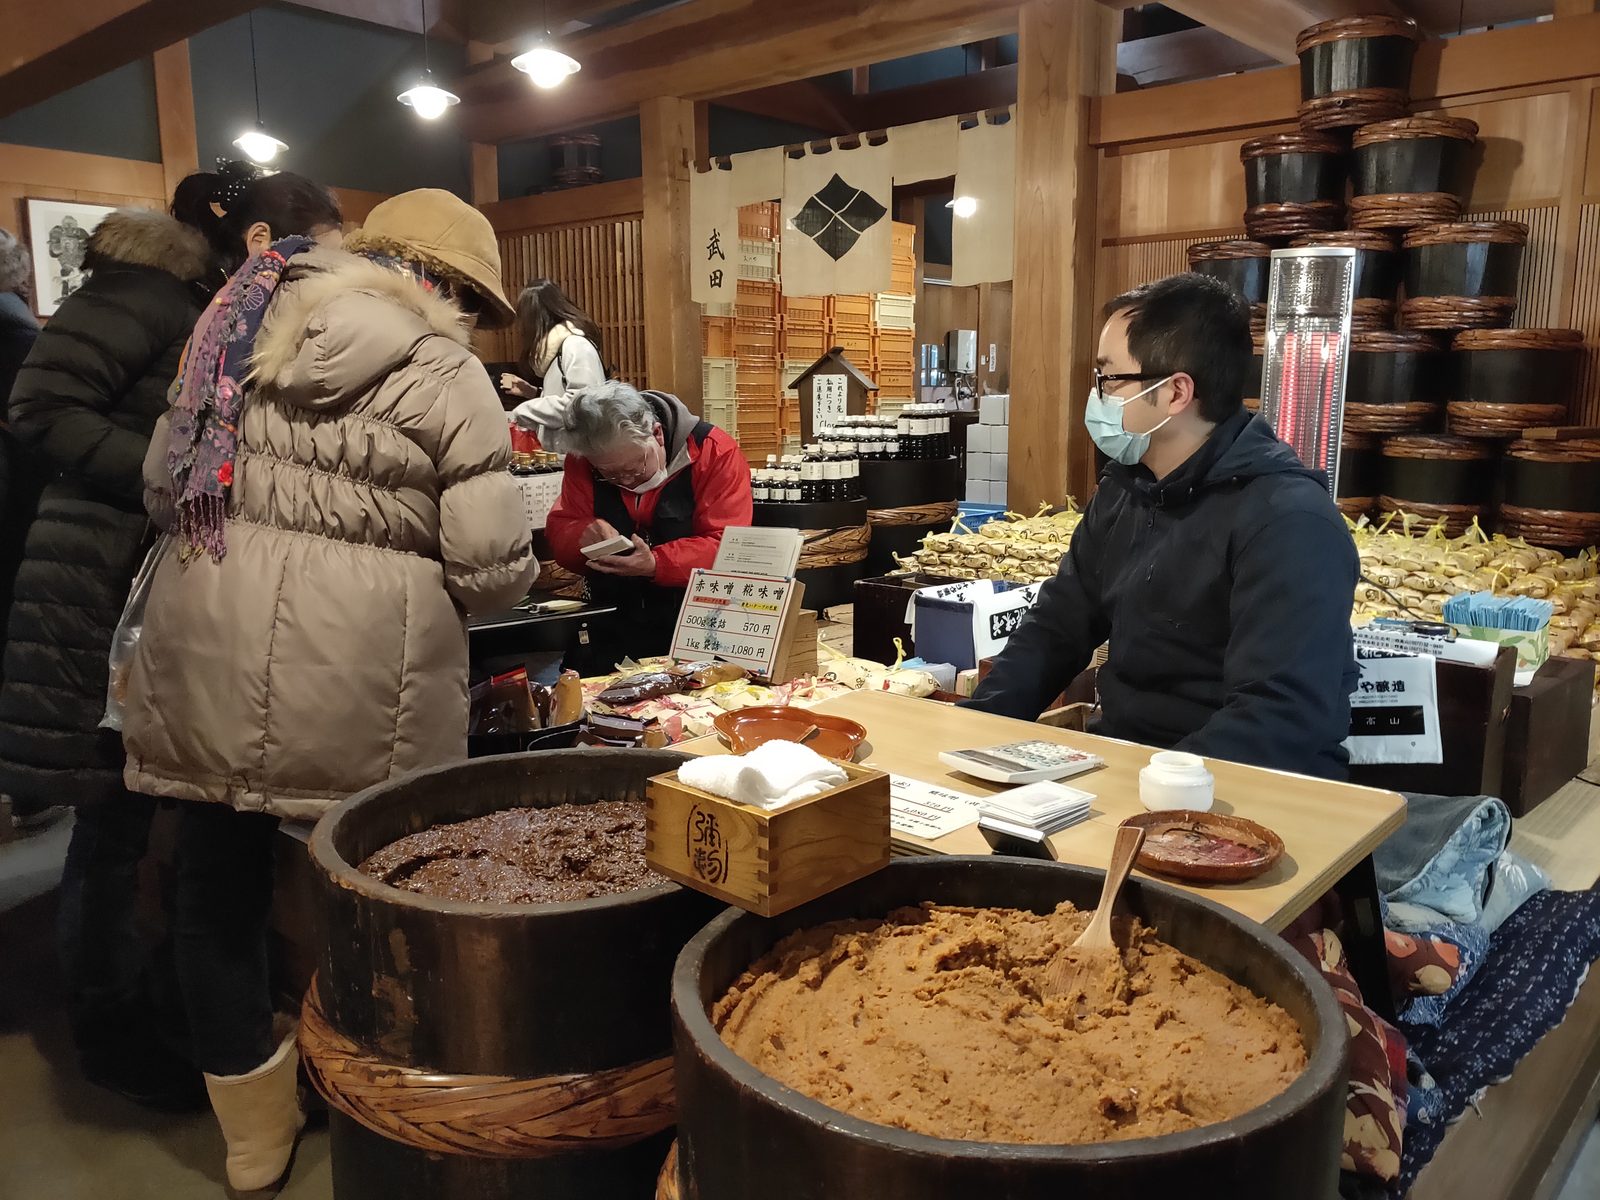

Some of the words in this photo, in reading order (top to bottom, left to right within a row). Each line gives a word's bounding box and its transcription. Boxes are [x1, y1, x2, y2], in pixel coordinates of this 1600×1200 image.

[706, 228, 725, 289] 武田
[695, 580, 734, 595] 赤味噌
[686, 615, 706, 628] 500g
[743, 622, 760, 633] 570
[762, 624, 771, 635] 円
[686, 638, 700, 649] 1kg
[731, 644, 754, 656] 1,080
[756, 647, 765, 658] 円
